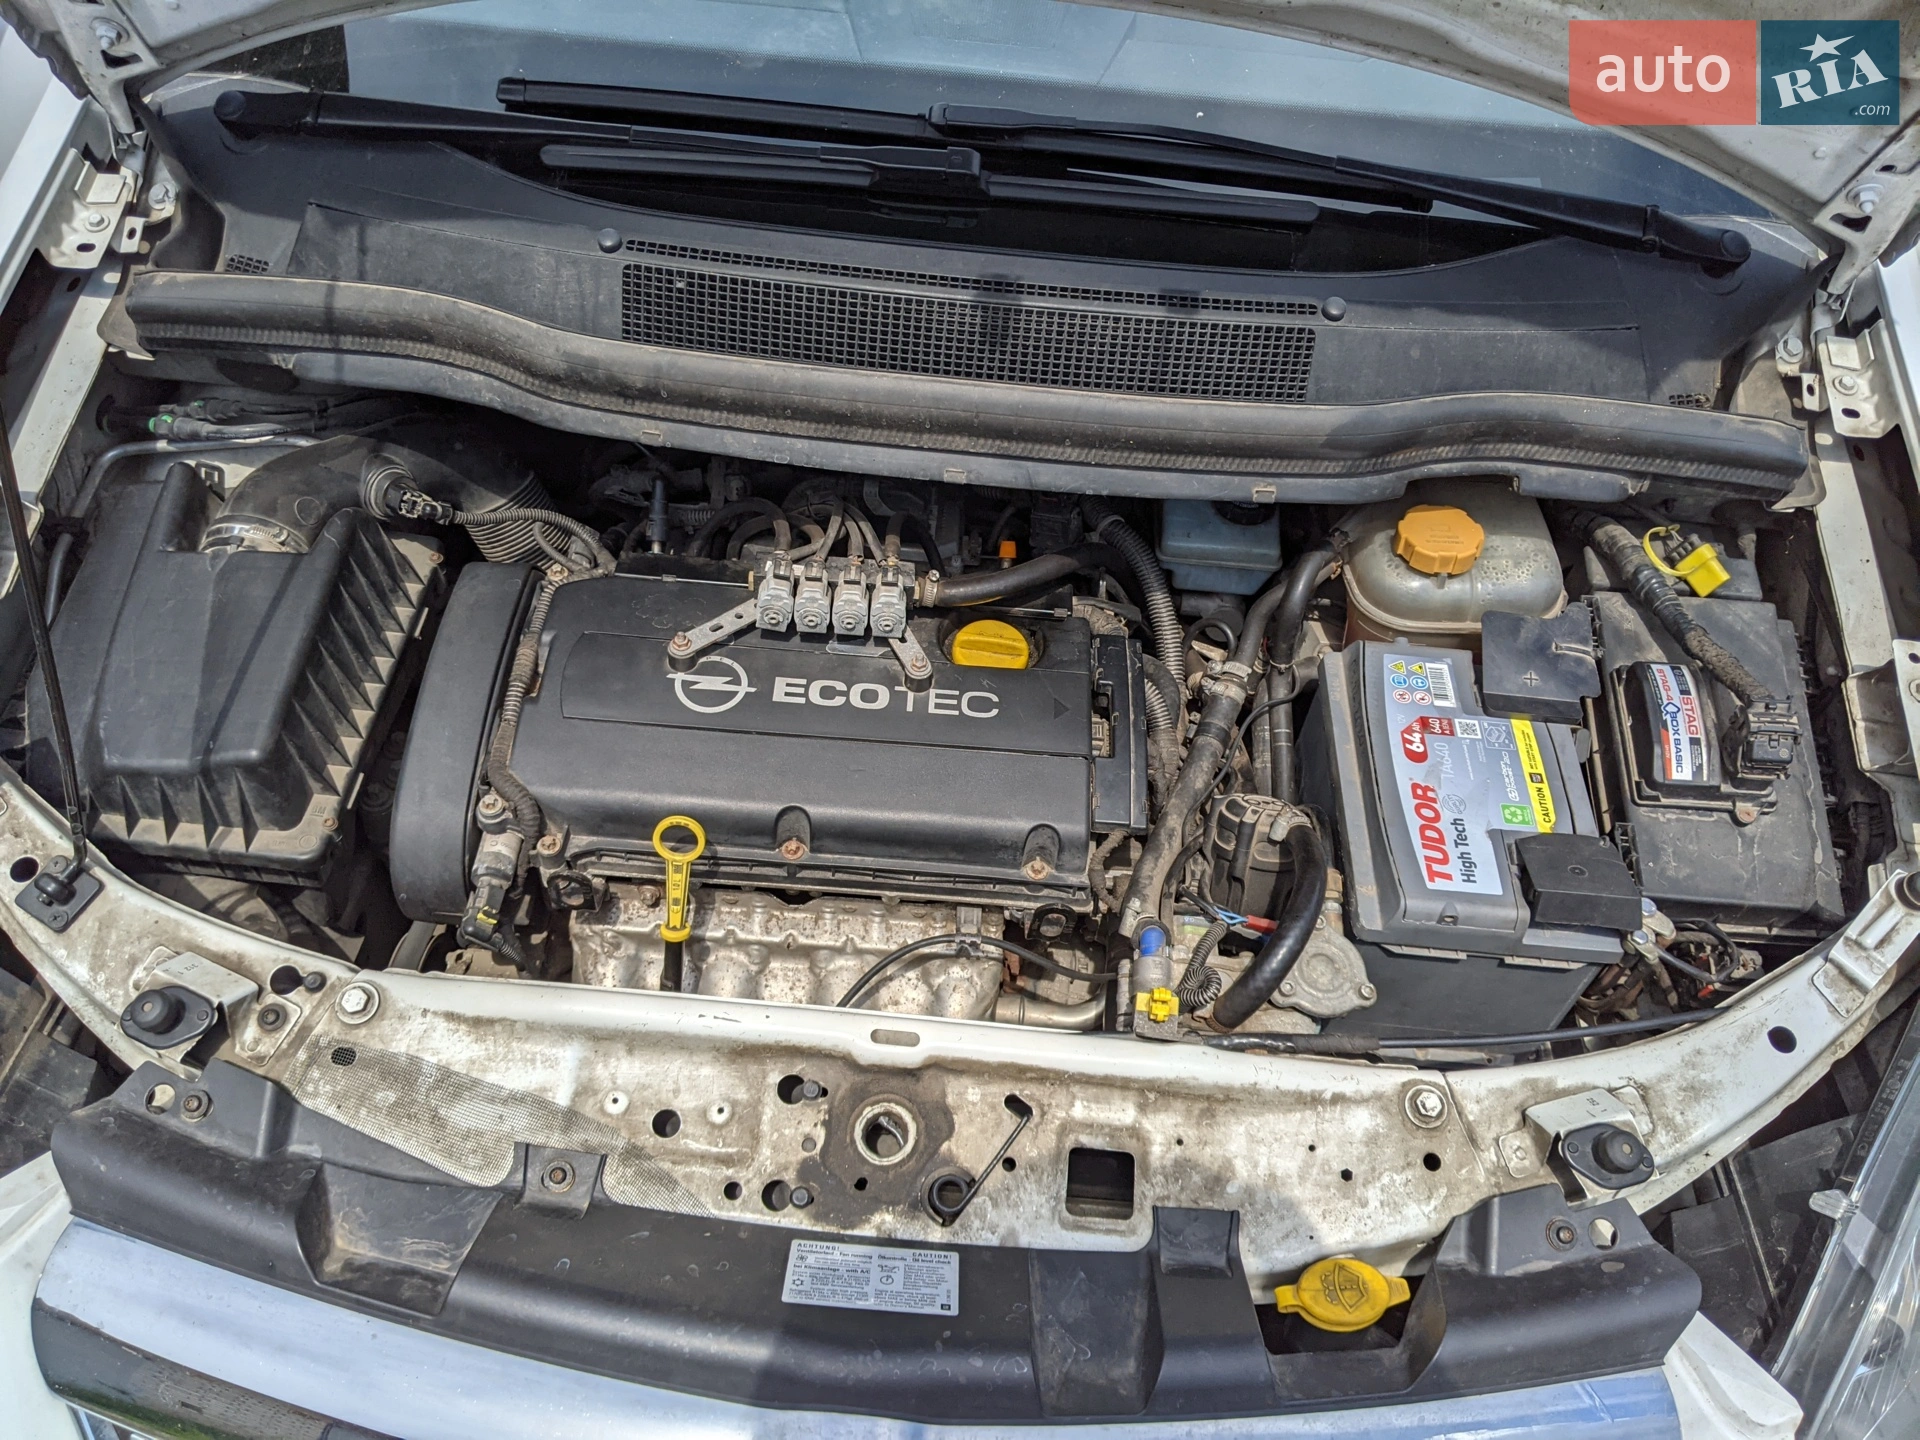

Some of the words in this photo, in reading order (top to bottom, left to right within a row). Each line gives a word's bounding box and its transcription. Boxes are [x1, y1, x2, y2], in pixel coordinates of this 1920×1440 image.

[771, 676, 1000, 719] ECOTEC
[1412, 722, 1421, 732] Ah
[1428, 718, 1442, 734] 640
[1656, 668, 1674, 702] STAG-4
[1674, 738, 1683, 774] BASIC
[1682, 696, 1699, 736] STAG
[1403, 731, 1425, 753] 64
[1535, 786, 1552, 823] CAUTION
[1411, 782, 1454, 883] TUDOR
[1450, 817, 1470, 848] Tech
[1457, 851, 1478, 884] High
[797, 1242, 840, 1251] ACHTUNG!
[912, 1252, 952, 1260] CAUTION!
